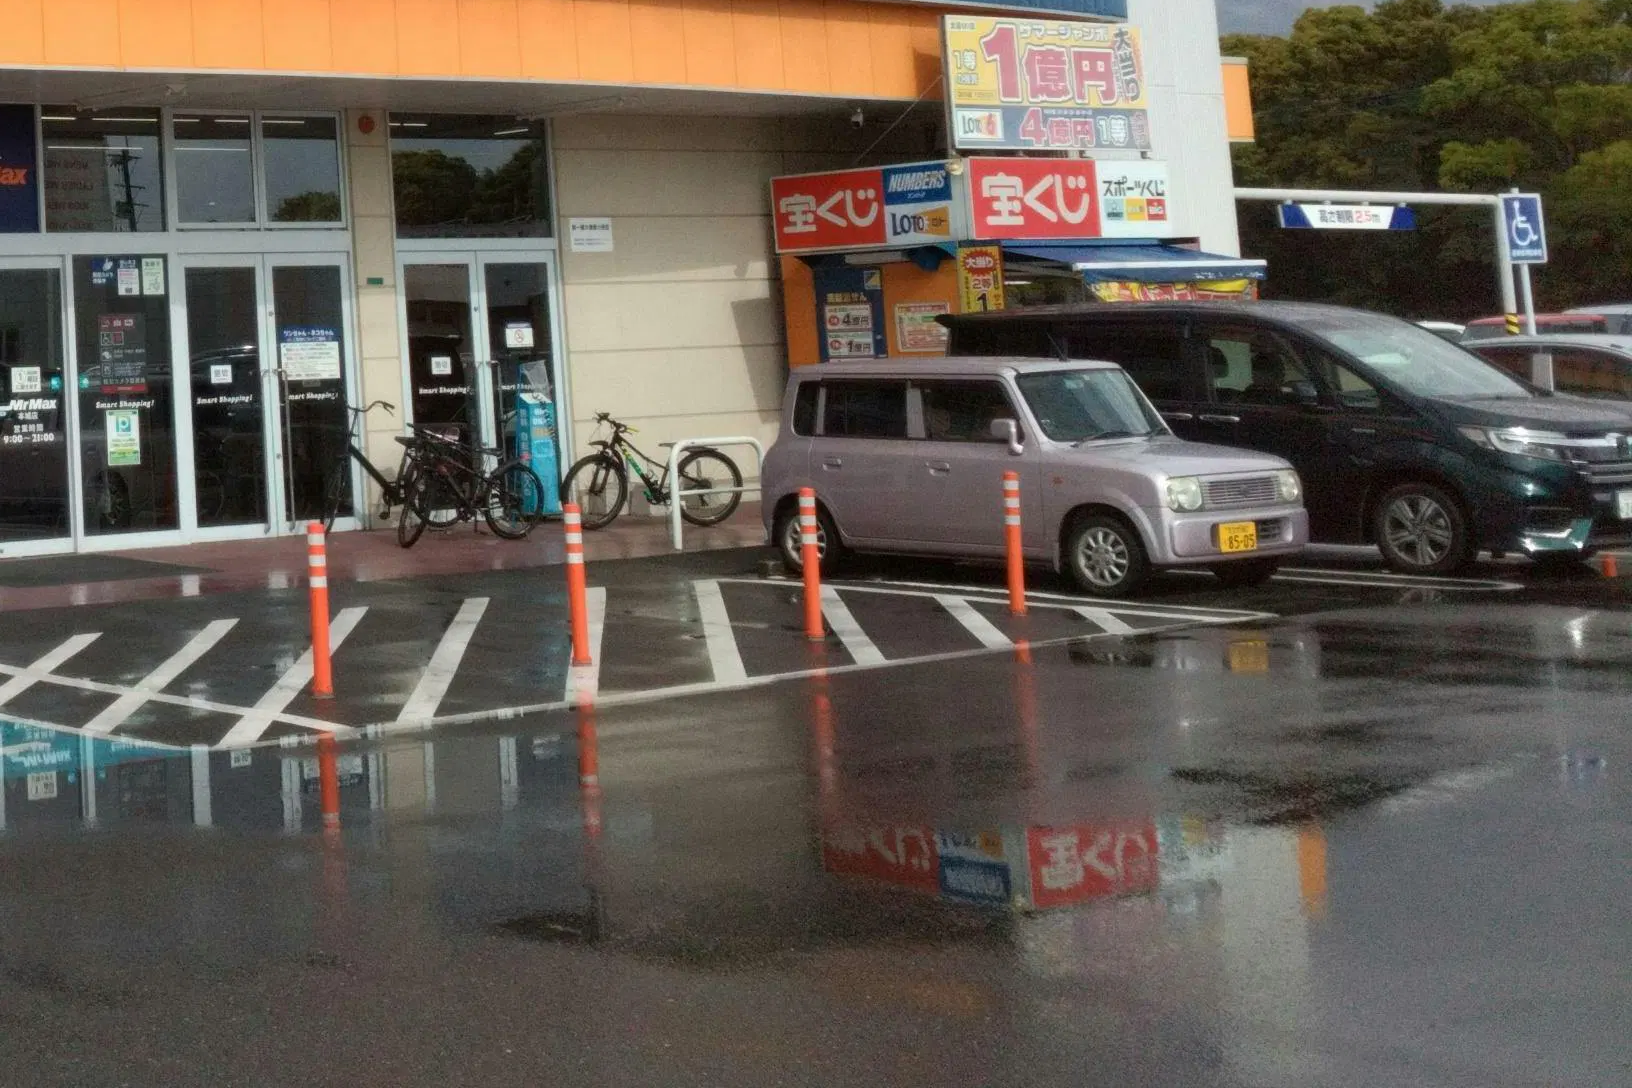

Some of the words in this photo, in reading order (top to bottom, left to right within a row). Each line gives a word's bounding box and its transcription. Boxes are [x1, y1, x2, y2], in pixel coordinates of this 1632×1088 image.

[1019, 22, 1109, 42] サマージャンボ
[980, 21, 1117, 105] 1億円
[1020, 107, 1096, 148] 4億円
[1097, 115, 1129, 146] 1等
[888, 169, 946, 192] NUMBERS
[1102, 175, 1165, 198] スポーツくじ
[779, 186, 880, 234] 宝くじ
[981, 171, 1091, 227] 宝くじ
[891, 207, 925, 236] LOTO
[965, 255, 994, 269] 大当り
[96, 401, 118, 409] Smart
[197, 397, 217, 405] Smart
